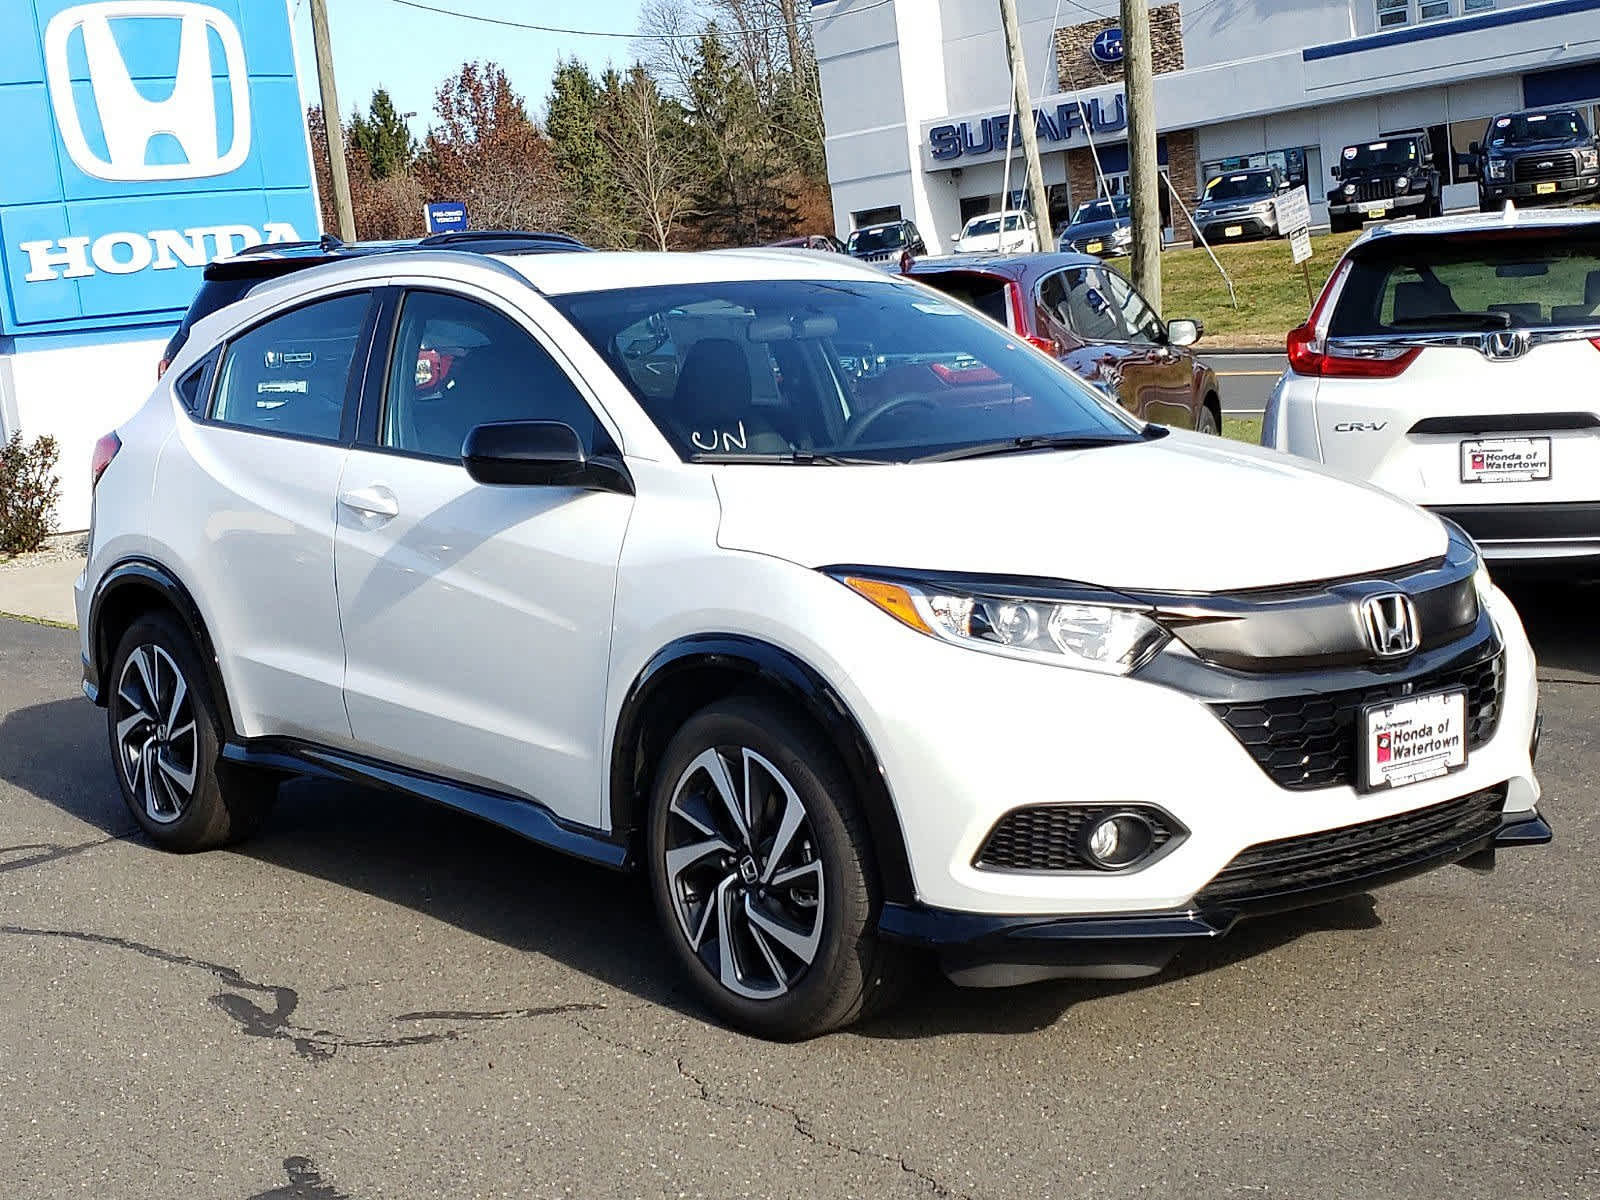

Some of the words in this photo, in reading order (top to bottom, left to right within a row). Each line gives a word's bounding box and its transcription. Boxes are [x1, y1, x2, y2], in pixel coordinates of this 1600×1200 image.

[929, 94, 1127, 161] SUBARU
[1334, 421, 1388, 432] CR-V
[1485, 453, 1521, 461] Honda
[1526, 451, 1538, 460] of
[1485, 460, 1547, 470] Watertown
[1393, 724, 1433, 745] Honda
[1437, 718, 1449, 734] of
[1393, 735, 1459, 760] Watertown
